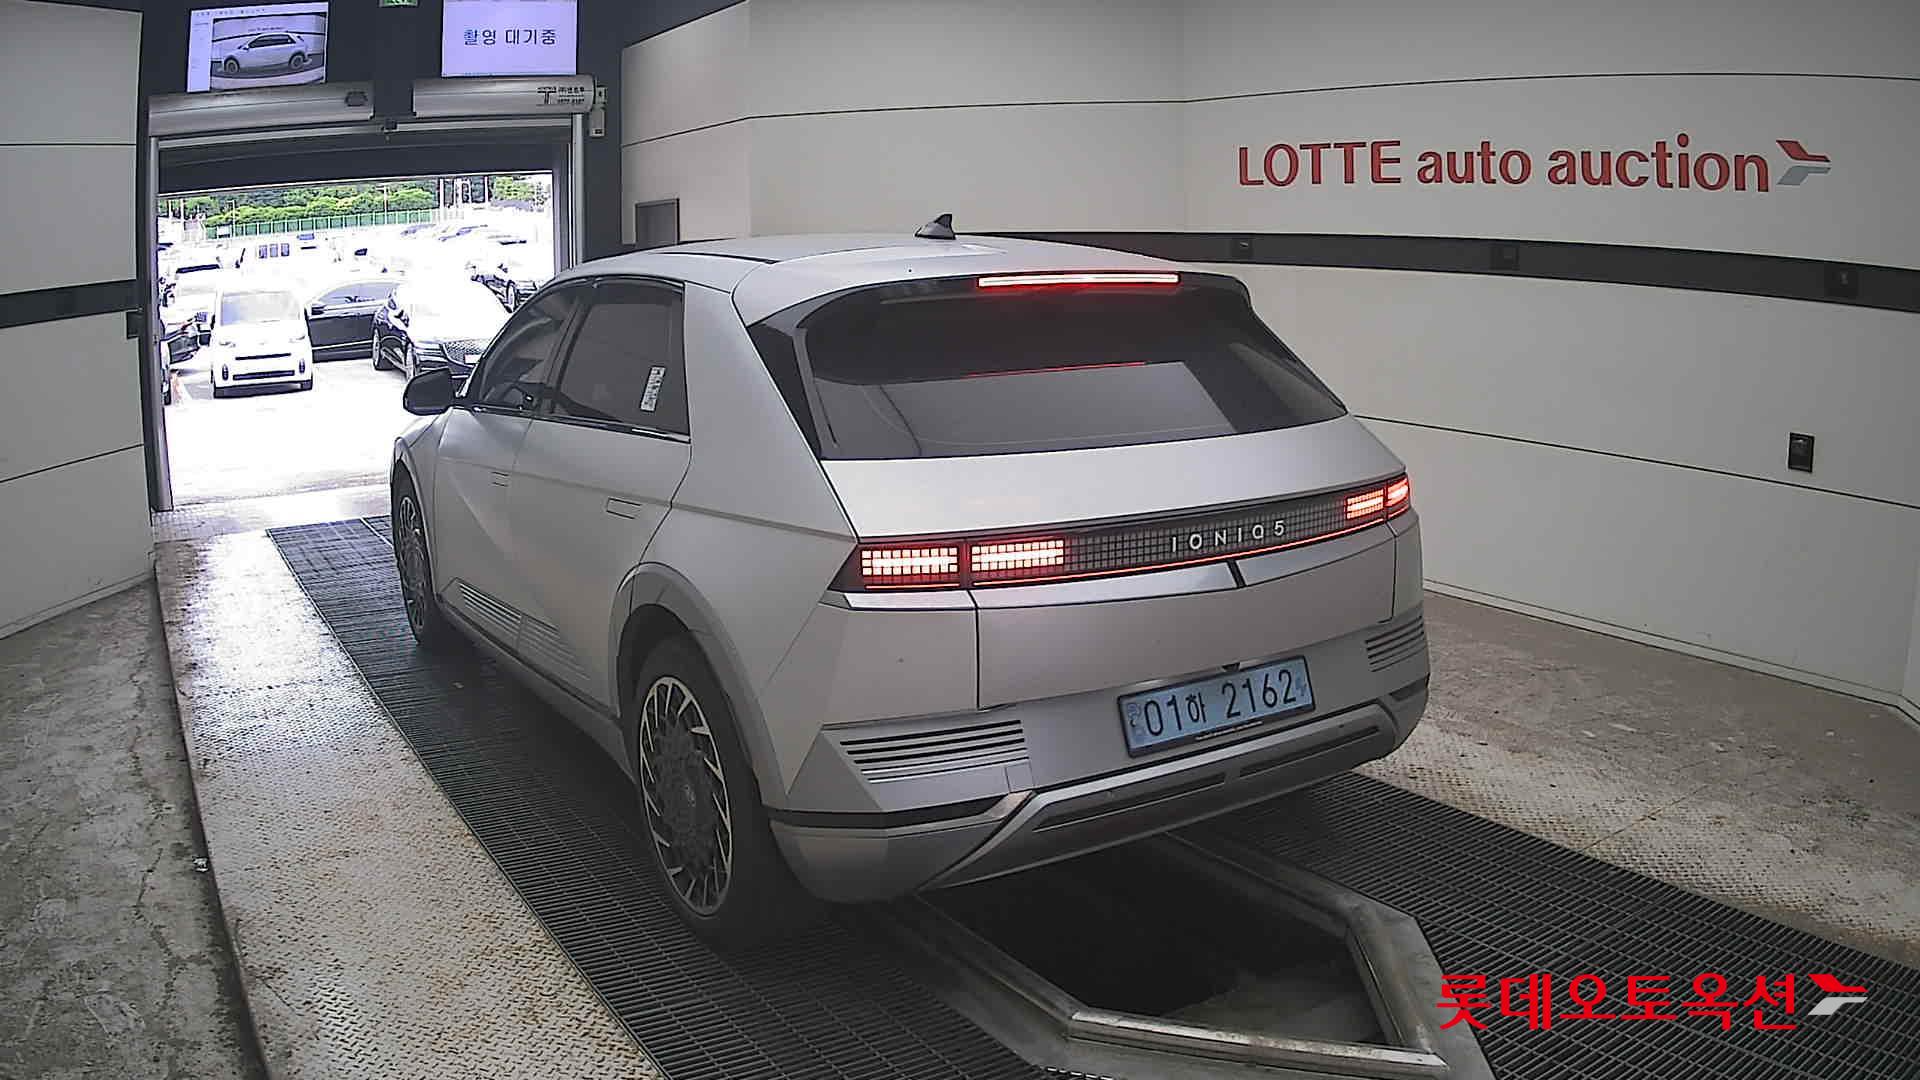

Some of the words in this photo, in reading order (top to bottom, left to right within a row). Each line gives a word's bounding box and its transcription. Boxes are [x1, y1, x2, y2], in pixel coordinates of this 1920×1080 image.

[505, 29, 556, 46] 대기중
[1238, 140, 1401, 187] LOTTE
[1416, 140, 1532, 185] auto
[1547, 133, 1770, 193] auction
[1221, 669, 1298, 719] 2162
